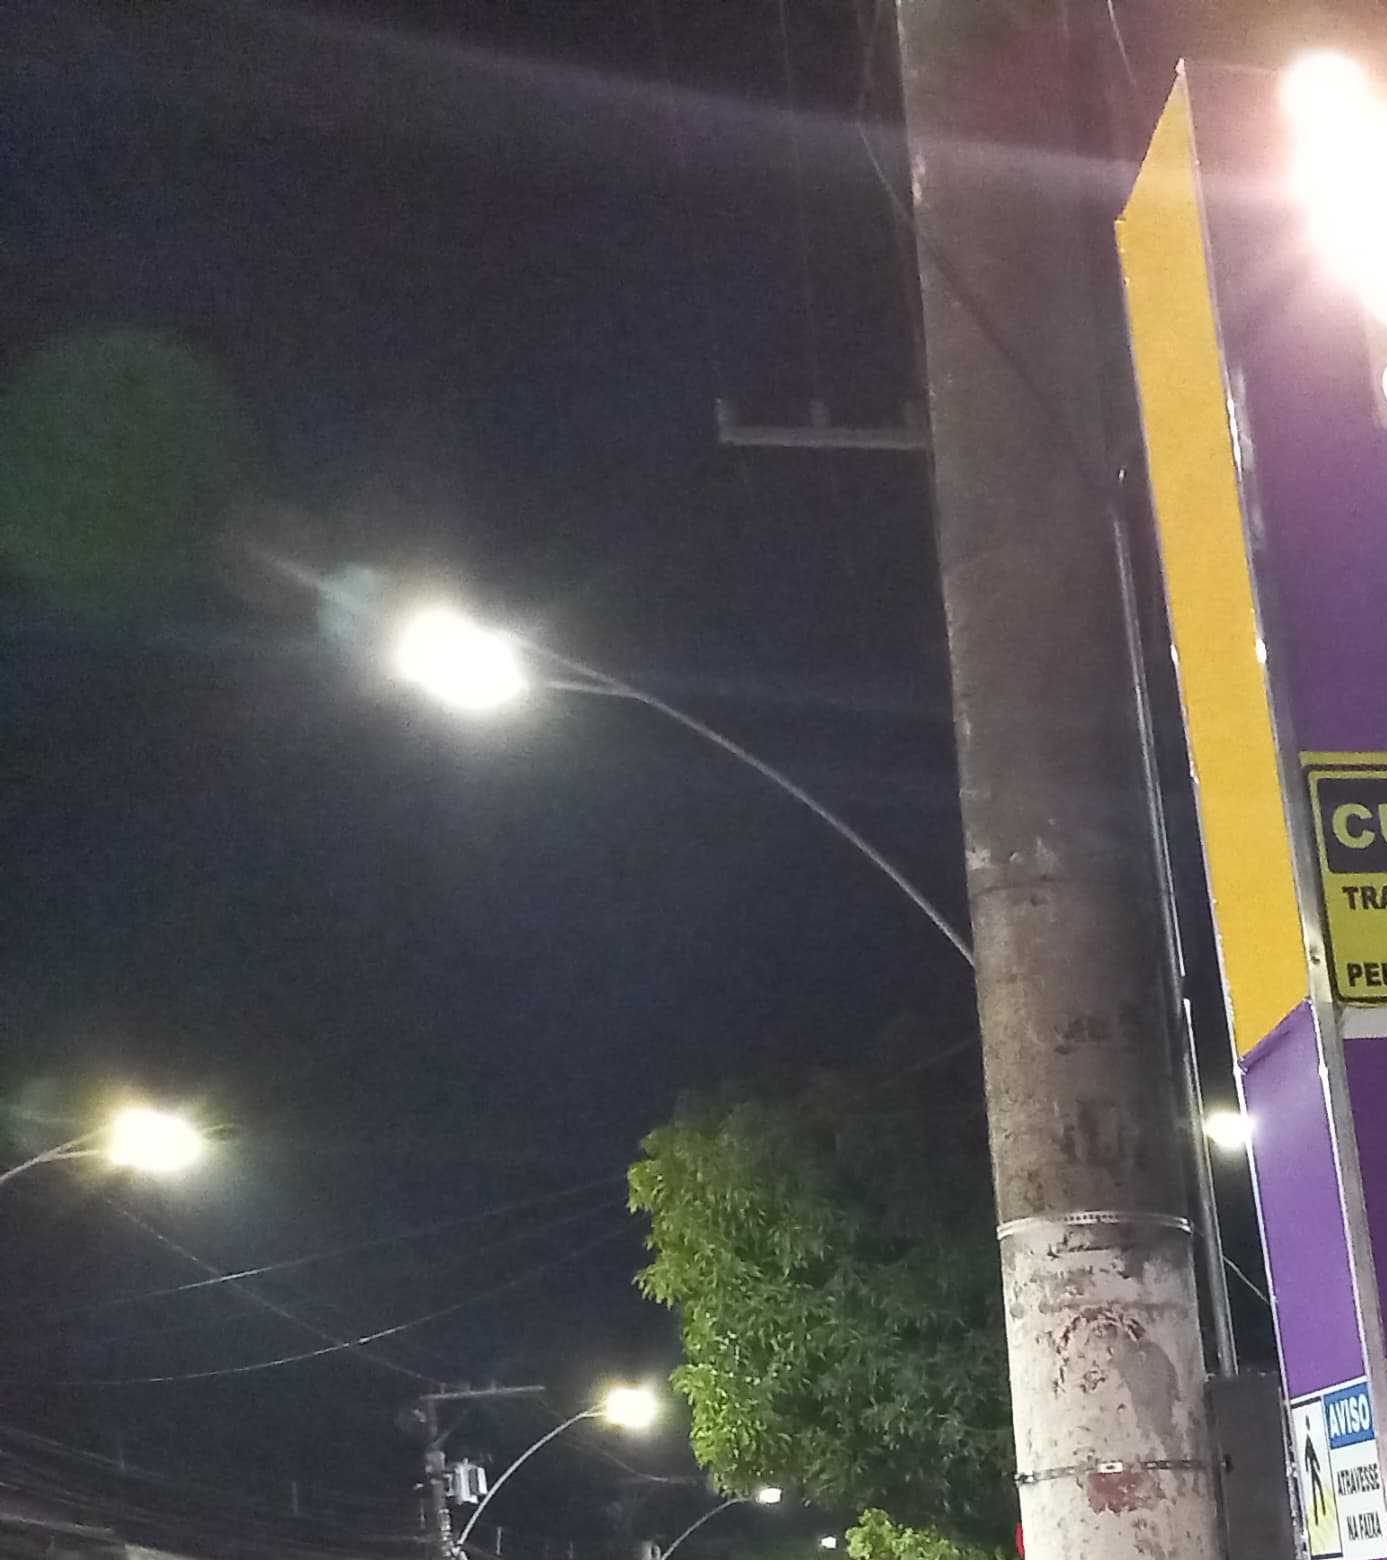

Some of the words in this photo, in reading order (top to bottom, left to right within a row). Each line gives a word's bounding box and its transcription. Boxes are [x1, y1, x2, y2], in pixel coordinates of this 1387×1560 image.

[1328, 1393, 1370, 1439] AVISO
[1336, 1463, 1380, 1496] ATRAVESSE
[1346, 1515, 1359, 1541] NA
[1358, 1511, 1383, 1540] FAIXA
